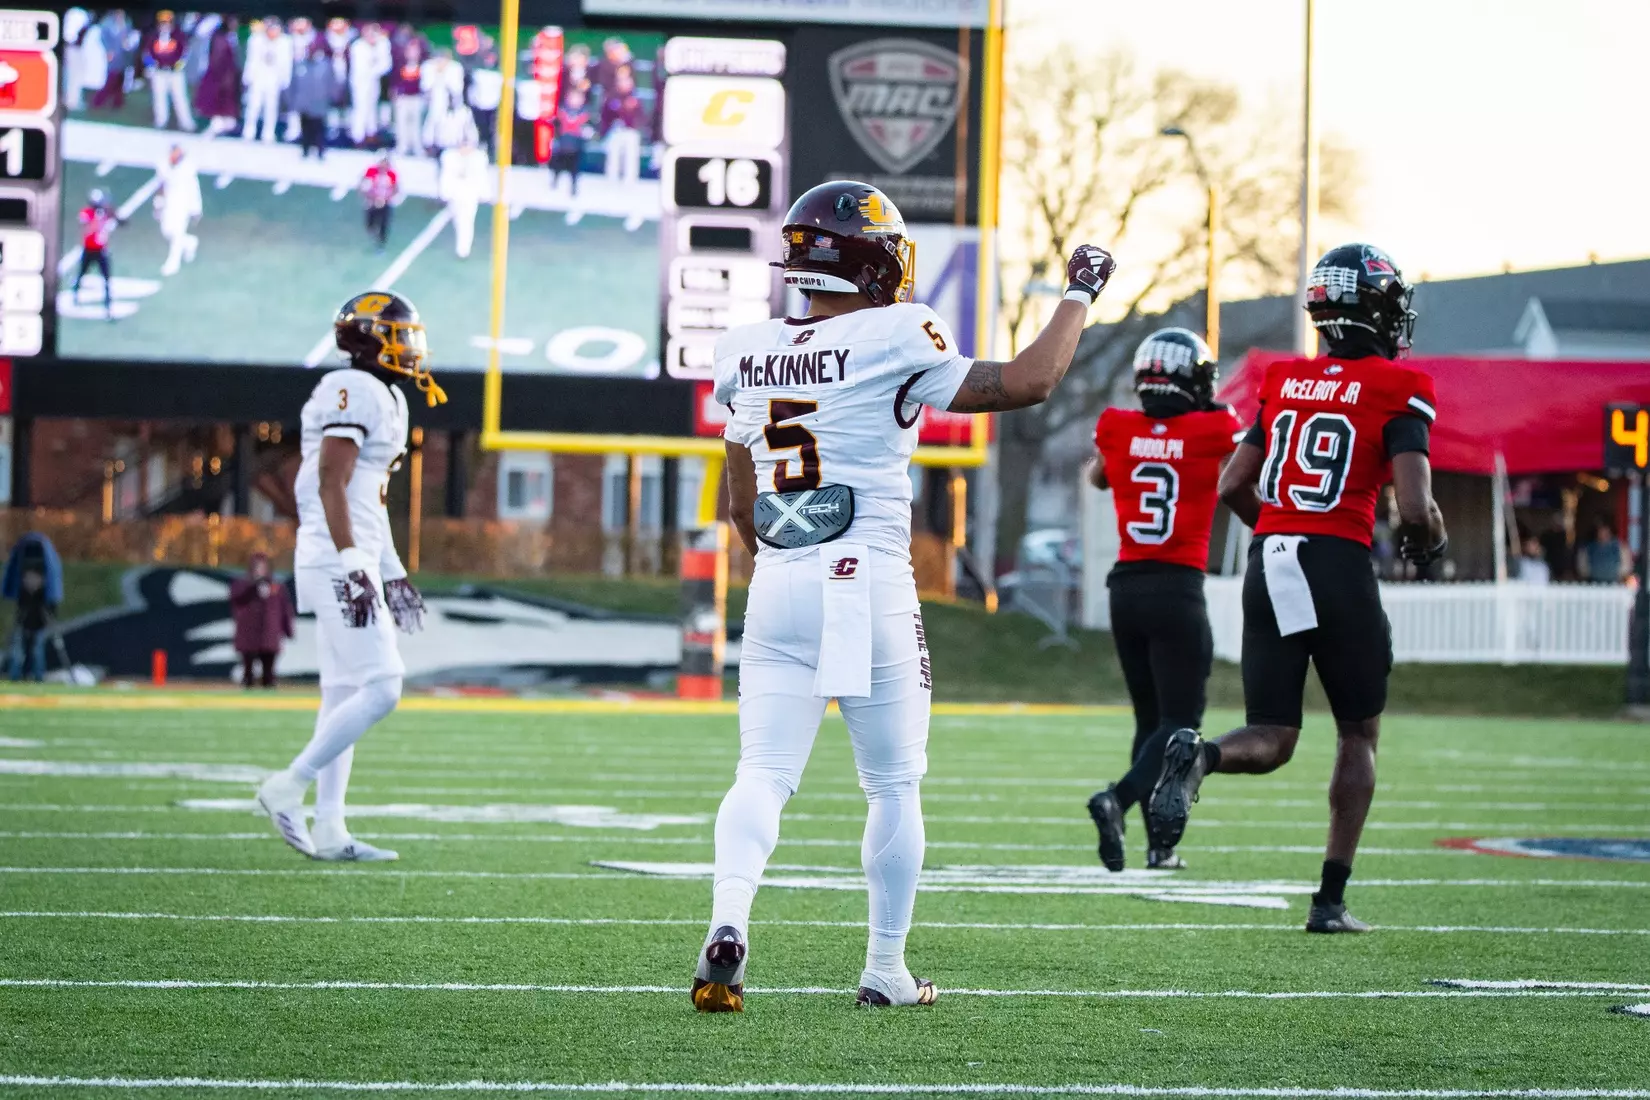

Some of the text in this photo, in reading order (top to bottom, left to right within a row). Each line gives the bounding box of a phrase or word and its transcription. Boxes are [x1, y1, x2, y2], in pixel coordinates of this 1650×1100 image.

[847, 83, 951, 115] MAC
[698, 157, 760, 207] 16
[921, 320, 947, 352] 5
[739, 348, 851, 388] McKINNEY
[338, 388, 348, 410] 3
[1280, 377, 1361, 405] McELROY JR
[763, 398, 822, 492] 5
[1611, 409, 1649, 468] 4
[1259, 410, 1356, 513] 19
[1127, 462, 1179, 544] 3
